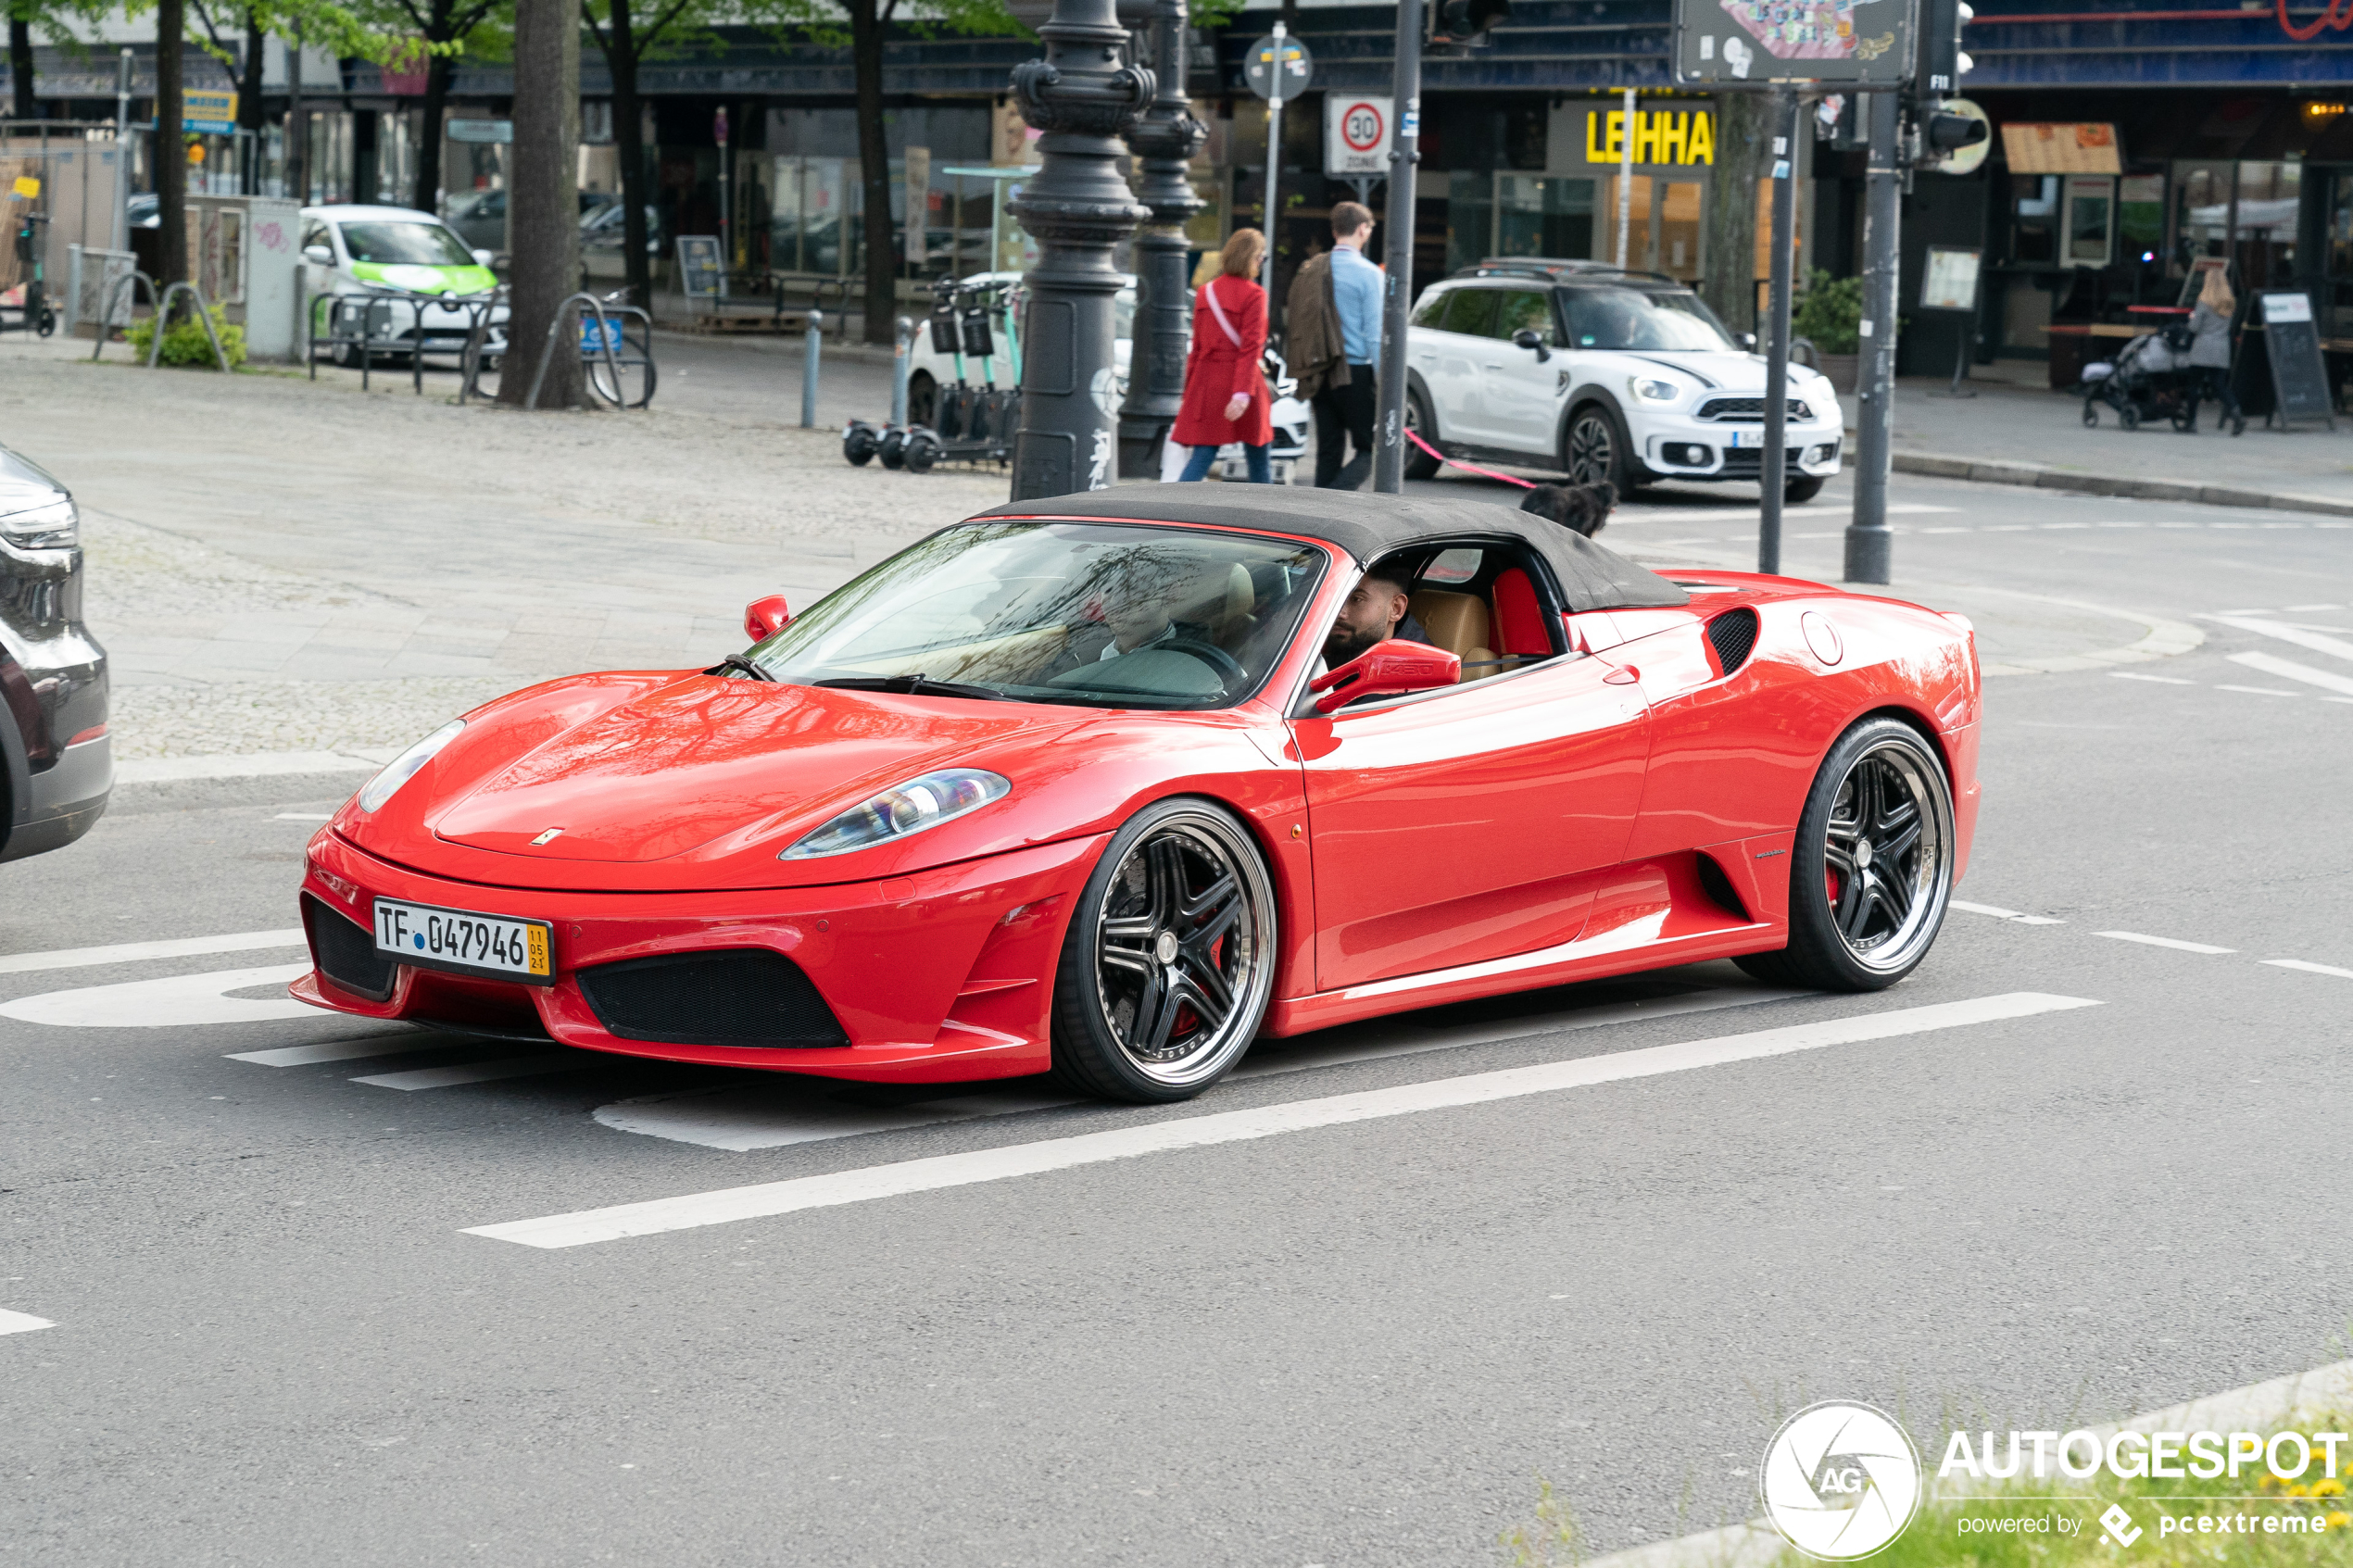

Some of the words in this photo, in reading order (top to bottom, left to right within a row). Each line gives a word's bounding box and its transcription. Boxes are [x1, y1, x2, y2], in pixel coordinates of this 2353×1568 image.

[1350, 117, 1374, 139] 30
[1587, 110, 1717, 165] LEIHHA
[379, 907, 408, 947] TF
[428, 915, 523, 966] 047946
[531, 930, 541, 942] 11
[531, 944, 543, 955] 05
